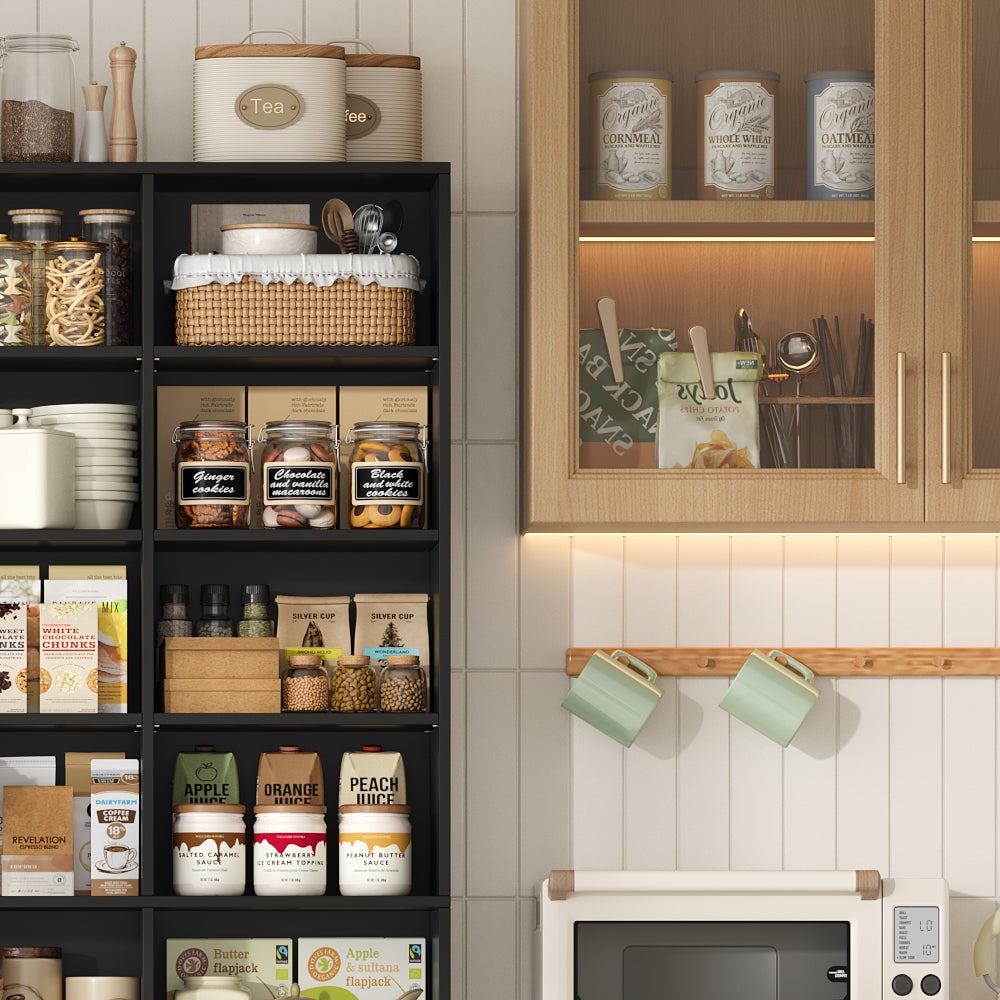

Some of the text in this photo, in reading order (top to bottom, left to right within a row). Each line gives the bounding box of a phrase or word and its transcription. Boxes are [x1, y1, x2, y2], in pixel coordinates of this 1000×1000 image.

[250, 98, 284, 114] Tea
[345, 109, 367, 123] fee
[602, 95, 658, 131] Organic
[708, 95, 765, 131] Organic
[603, 133, 662, 144] CORNMEAL
[708, 135, 772, 144] WHOLE WHEAT
[193, 470, 235, 484] Ginger
[274, 469, 326, 480] Chocolate
[370, 469, 404, 479] Black
[192, 483, 235, 494] cookies
[270, 480, 329, 488] and vanilla
[363, 479, 414, 489] and white
[366, 488, 409, 497] cookies
[102, 602, 120, 613] MIX
[42, 641, 96, 649] CHUNKS
[184, 783, 229, 796] APPLE
[264, 783, 319, 796] ORANGE
[350, 777, 399, 792] PEACH
[357, 794, 395, 805] JUICE
[12, 836, 66, 844] REVELATION
[214, 949, 249, 959] Butter
[346, 947, 379, 961] Apple
[923, 944, 932, 956] 10
[213, 963, 258, 975] flapjack
[346, 963, 399, 973] & sultana
[346, 976, 392, 988] flapjack
